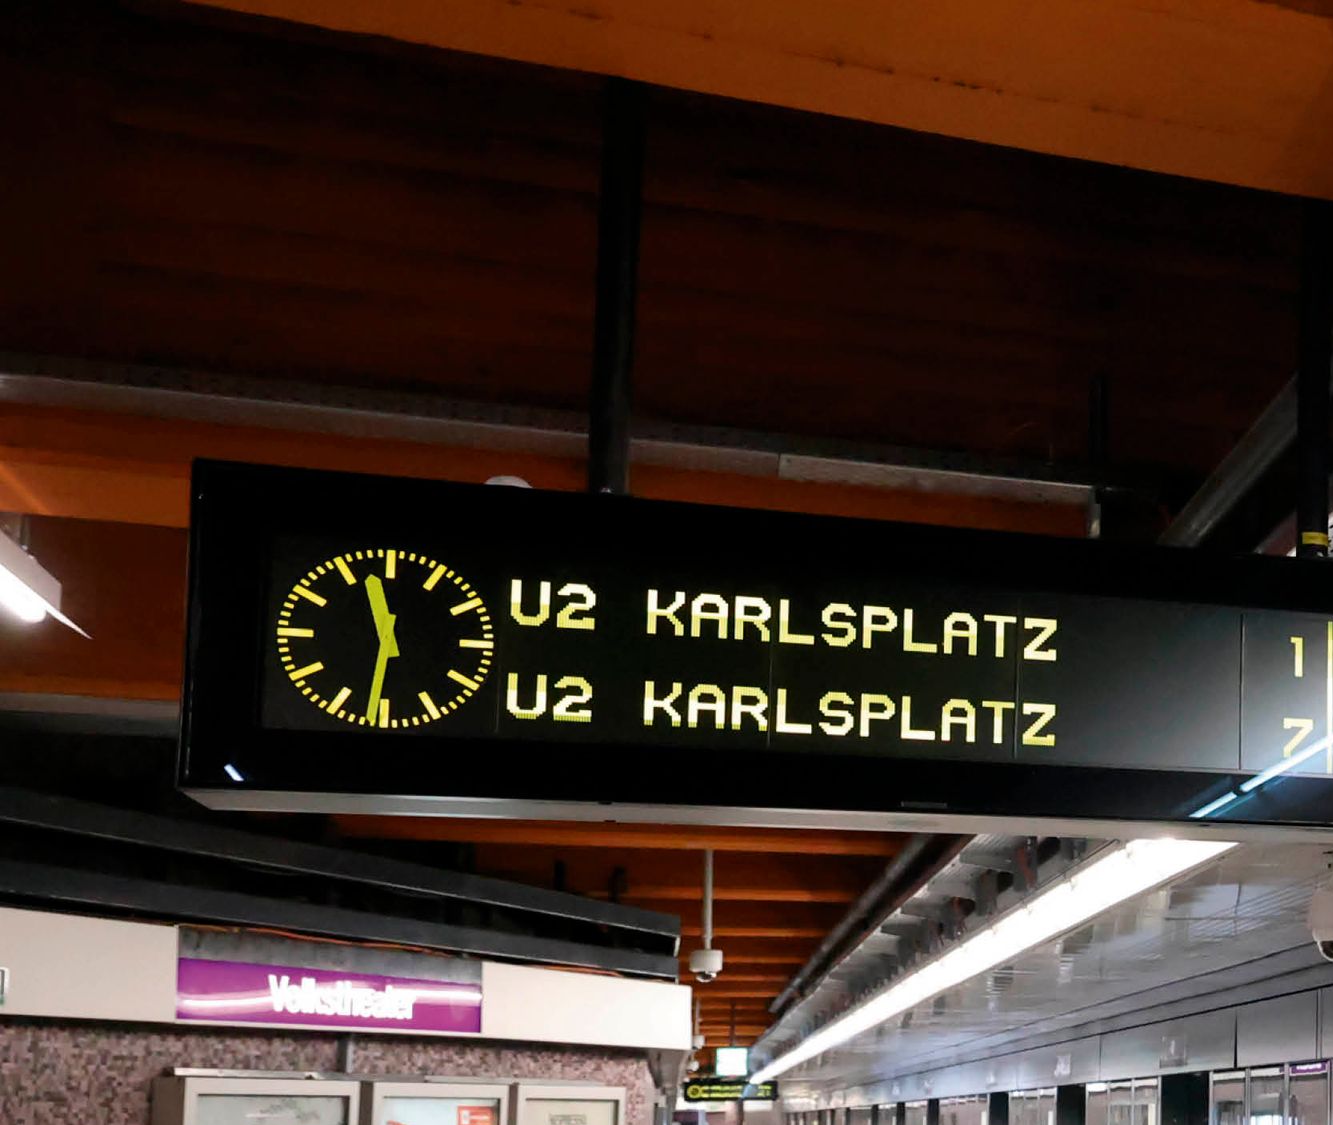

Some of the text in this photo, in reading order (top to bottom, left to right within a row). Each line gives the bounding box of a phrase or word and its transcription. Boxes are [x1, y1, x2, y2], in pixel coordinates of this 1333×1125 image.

[511, 579, 1303, 677] U2 KARLSPLATZ 1
[507, 672, 592, 722] U2
[643, 680, 1056, 746] KARLSPLATZ
[268, 974, 416, 1019] Volkstheater
